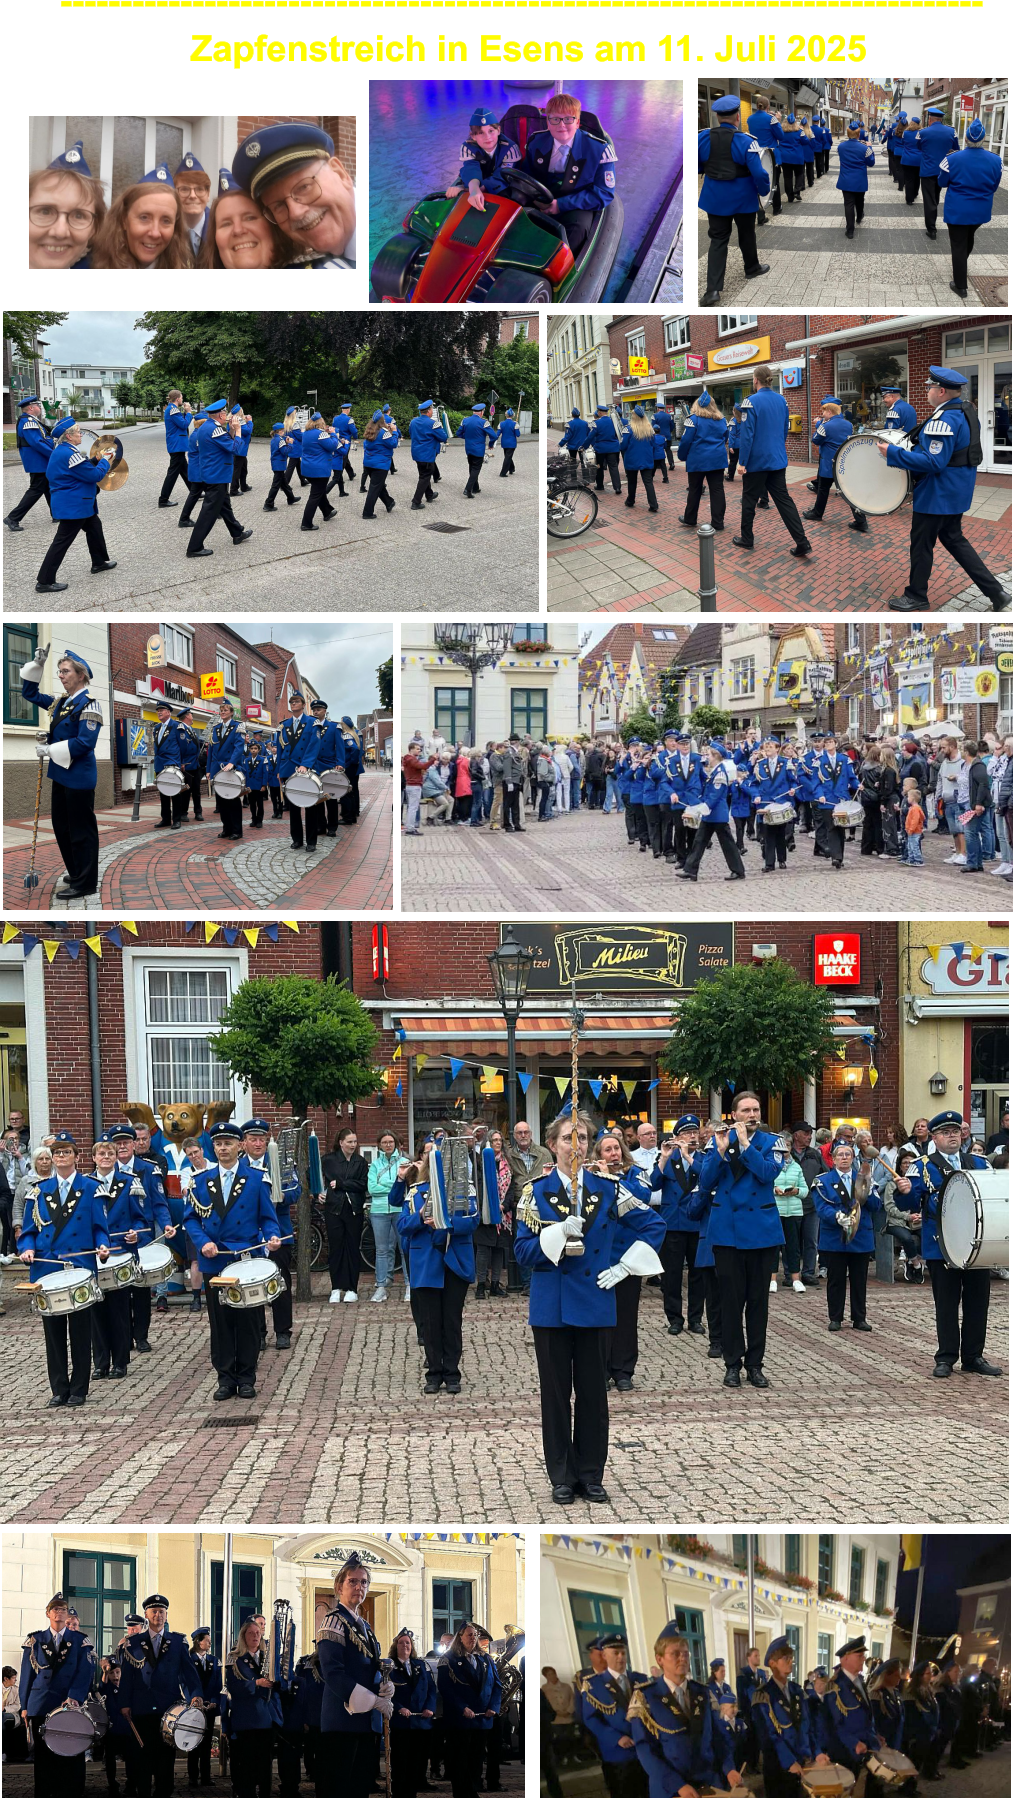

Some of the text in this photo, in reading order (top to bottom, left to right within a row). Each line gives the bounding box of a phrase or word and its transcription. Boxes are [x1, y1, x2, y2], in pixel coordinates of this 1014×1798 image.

[838, 438, 874, 475] Spielmannszug
[203, 688, 221, 696] LOTTO
[592, 943, 649, 968] Milieu
[698, 944, 724, 954] Pizza
[698, 956, 729, 967] Salate
[818, 953, 858, 966] HAAKE
[823, 965, 853, 978] BECK
[947, 953, 1009, 987] Gl
